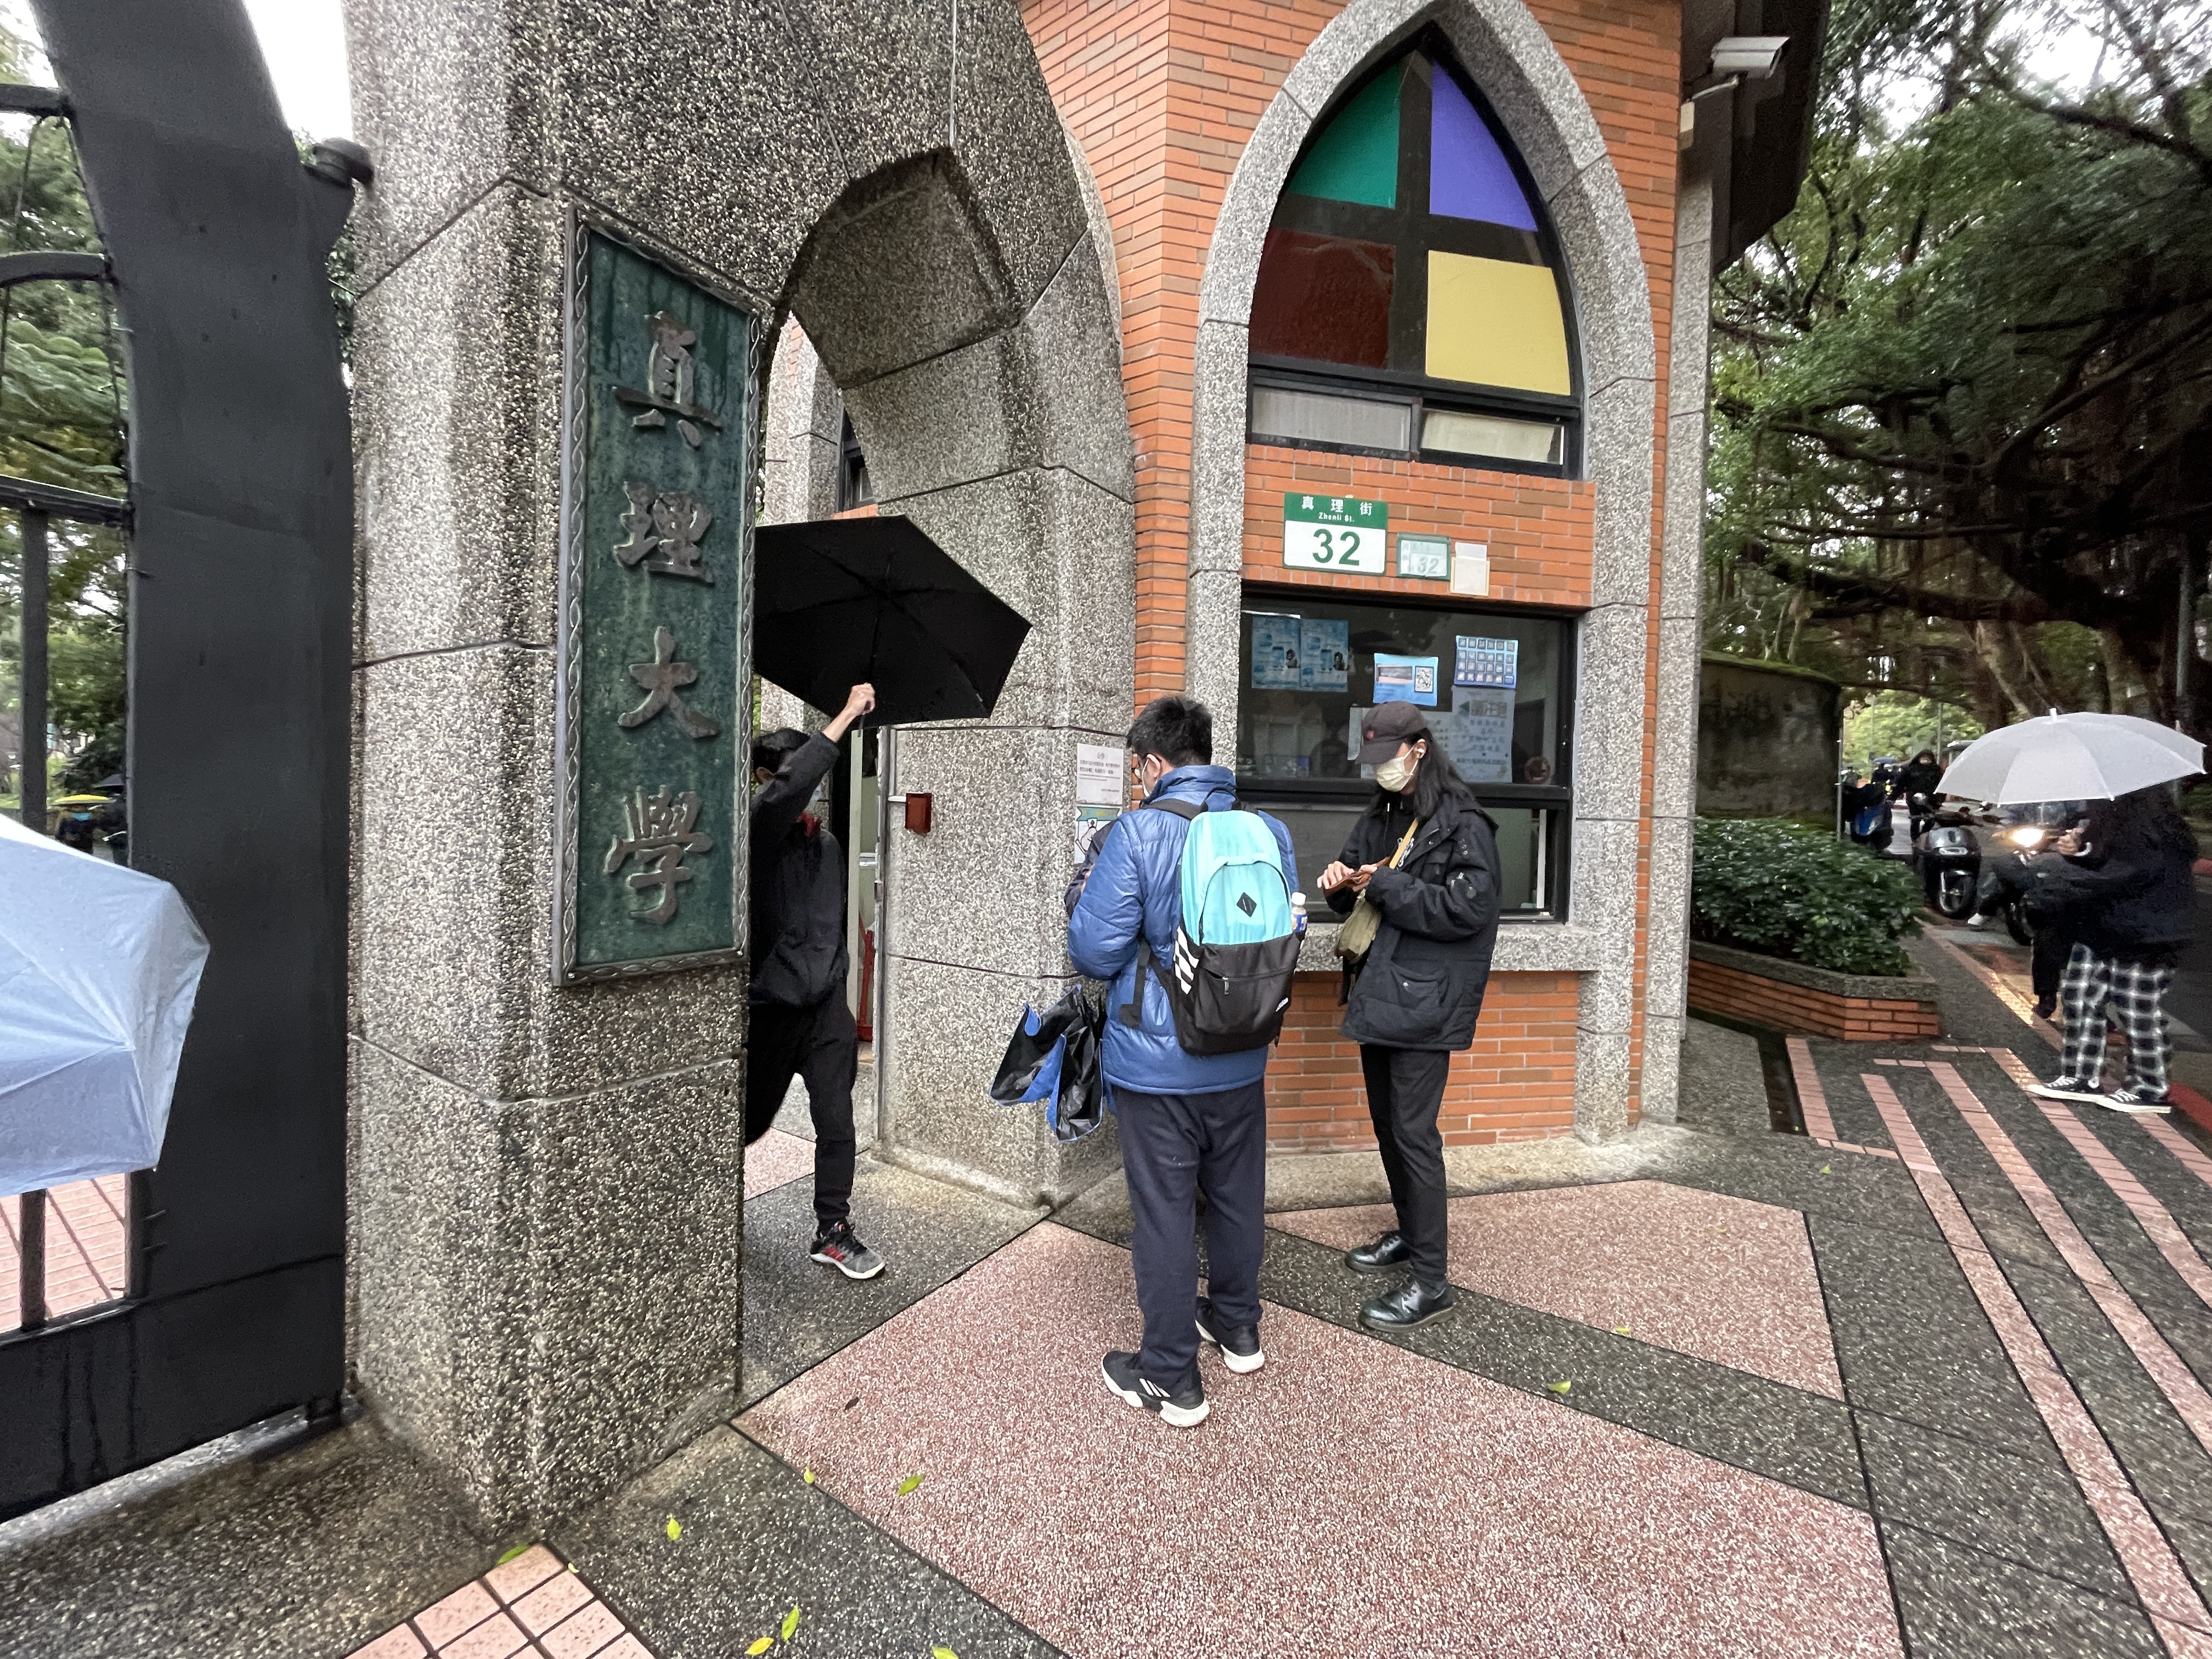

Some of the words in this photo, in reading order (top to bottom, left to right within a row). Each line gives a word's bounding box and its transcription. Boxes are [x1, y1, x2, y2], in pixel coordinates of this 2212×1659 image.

[1301, 495, 1373, 516] 真理街
[1318, 511, 1342, 521] Zhenli
[1312, 528, 1361, 566] 32
[1417, 556, 1440, 574] 32
